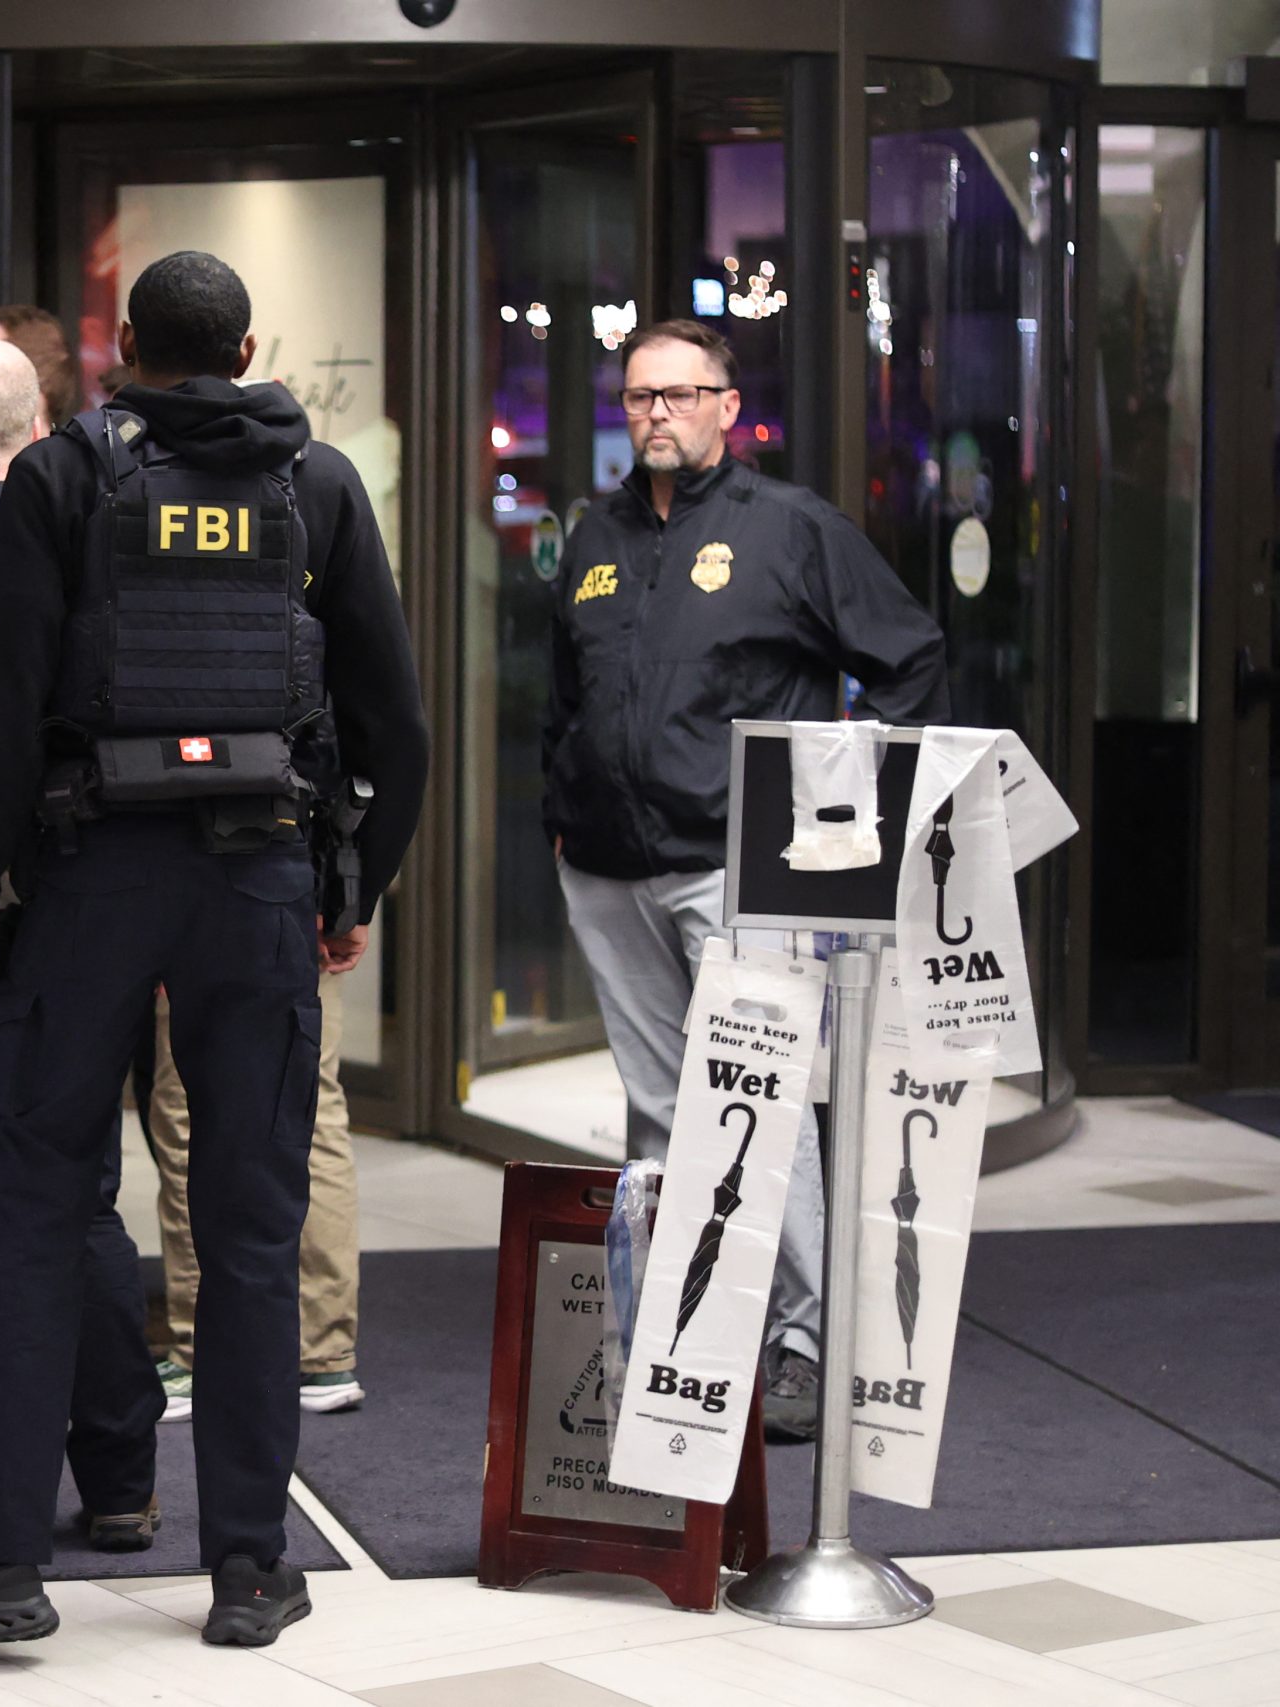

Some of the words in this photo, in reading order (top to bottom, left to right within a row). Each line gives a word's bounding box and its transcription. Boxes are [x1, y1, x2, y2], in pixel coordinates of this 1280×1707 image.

[160, 505, 249, 552] FBI
[582, 565, 617, 590] ATF
[923, 950, 1005, 985] Wet
[973, 994, 1010, 1008] floor
[708, 1014, 757, 1033] Please
[762, 1025, 799, 1043] keep
[926, 1018, 961, 1030] keep
[967, 1010, 1017, 1025] Please
[709, 1031, 746, 1048] floor
[707, 1058, 781, 1101] Wet
[562, 1299, 605, 1315] WET
[564, 1348, 604, 1410] CAUTION
[646, 1363, 731, 1413] Bag
[553, 1456, 608, 1476] PRECA
[546, 1474, 585, 1491] PISO
